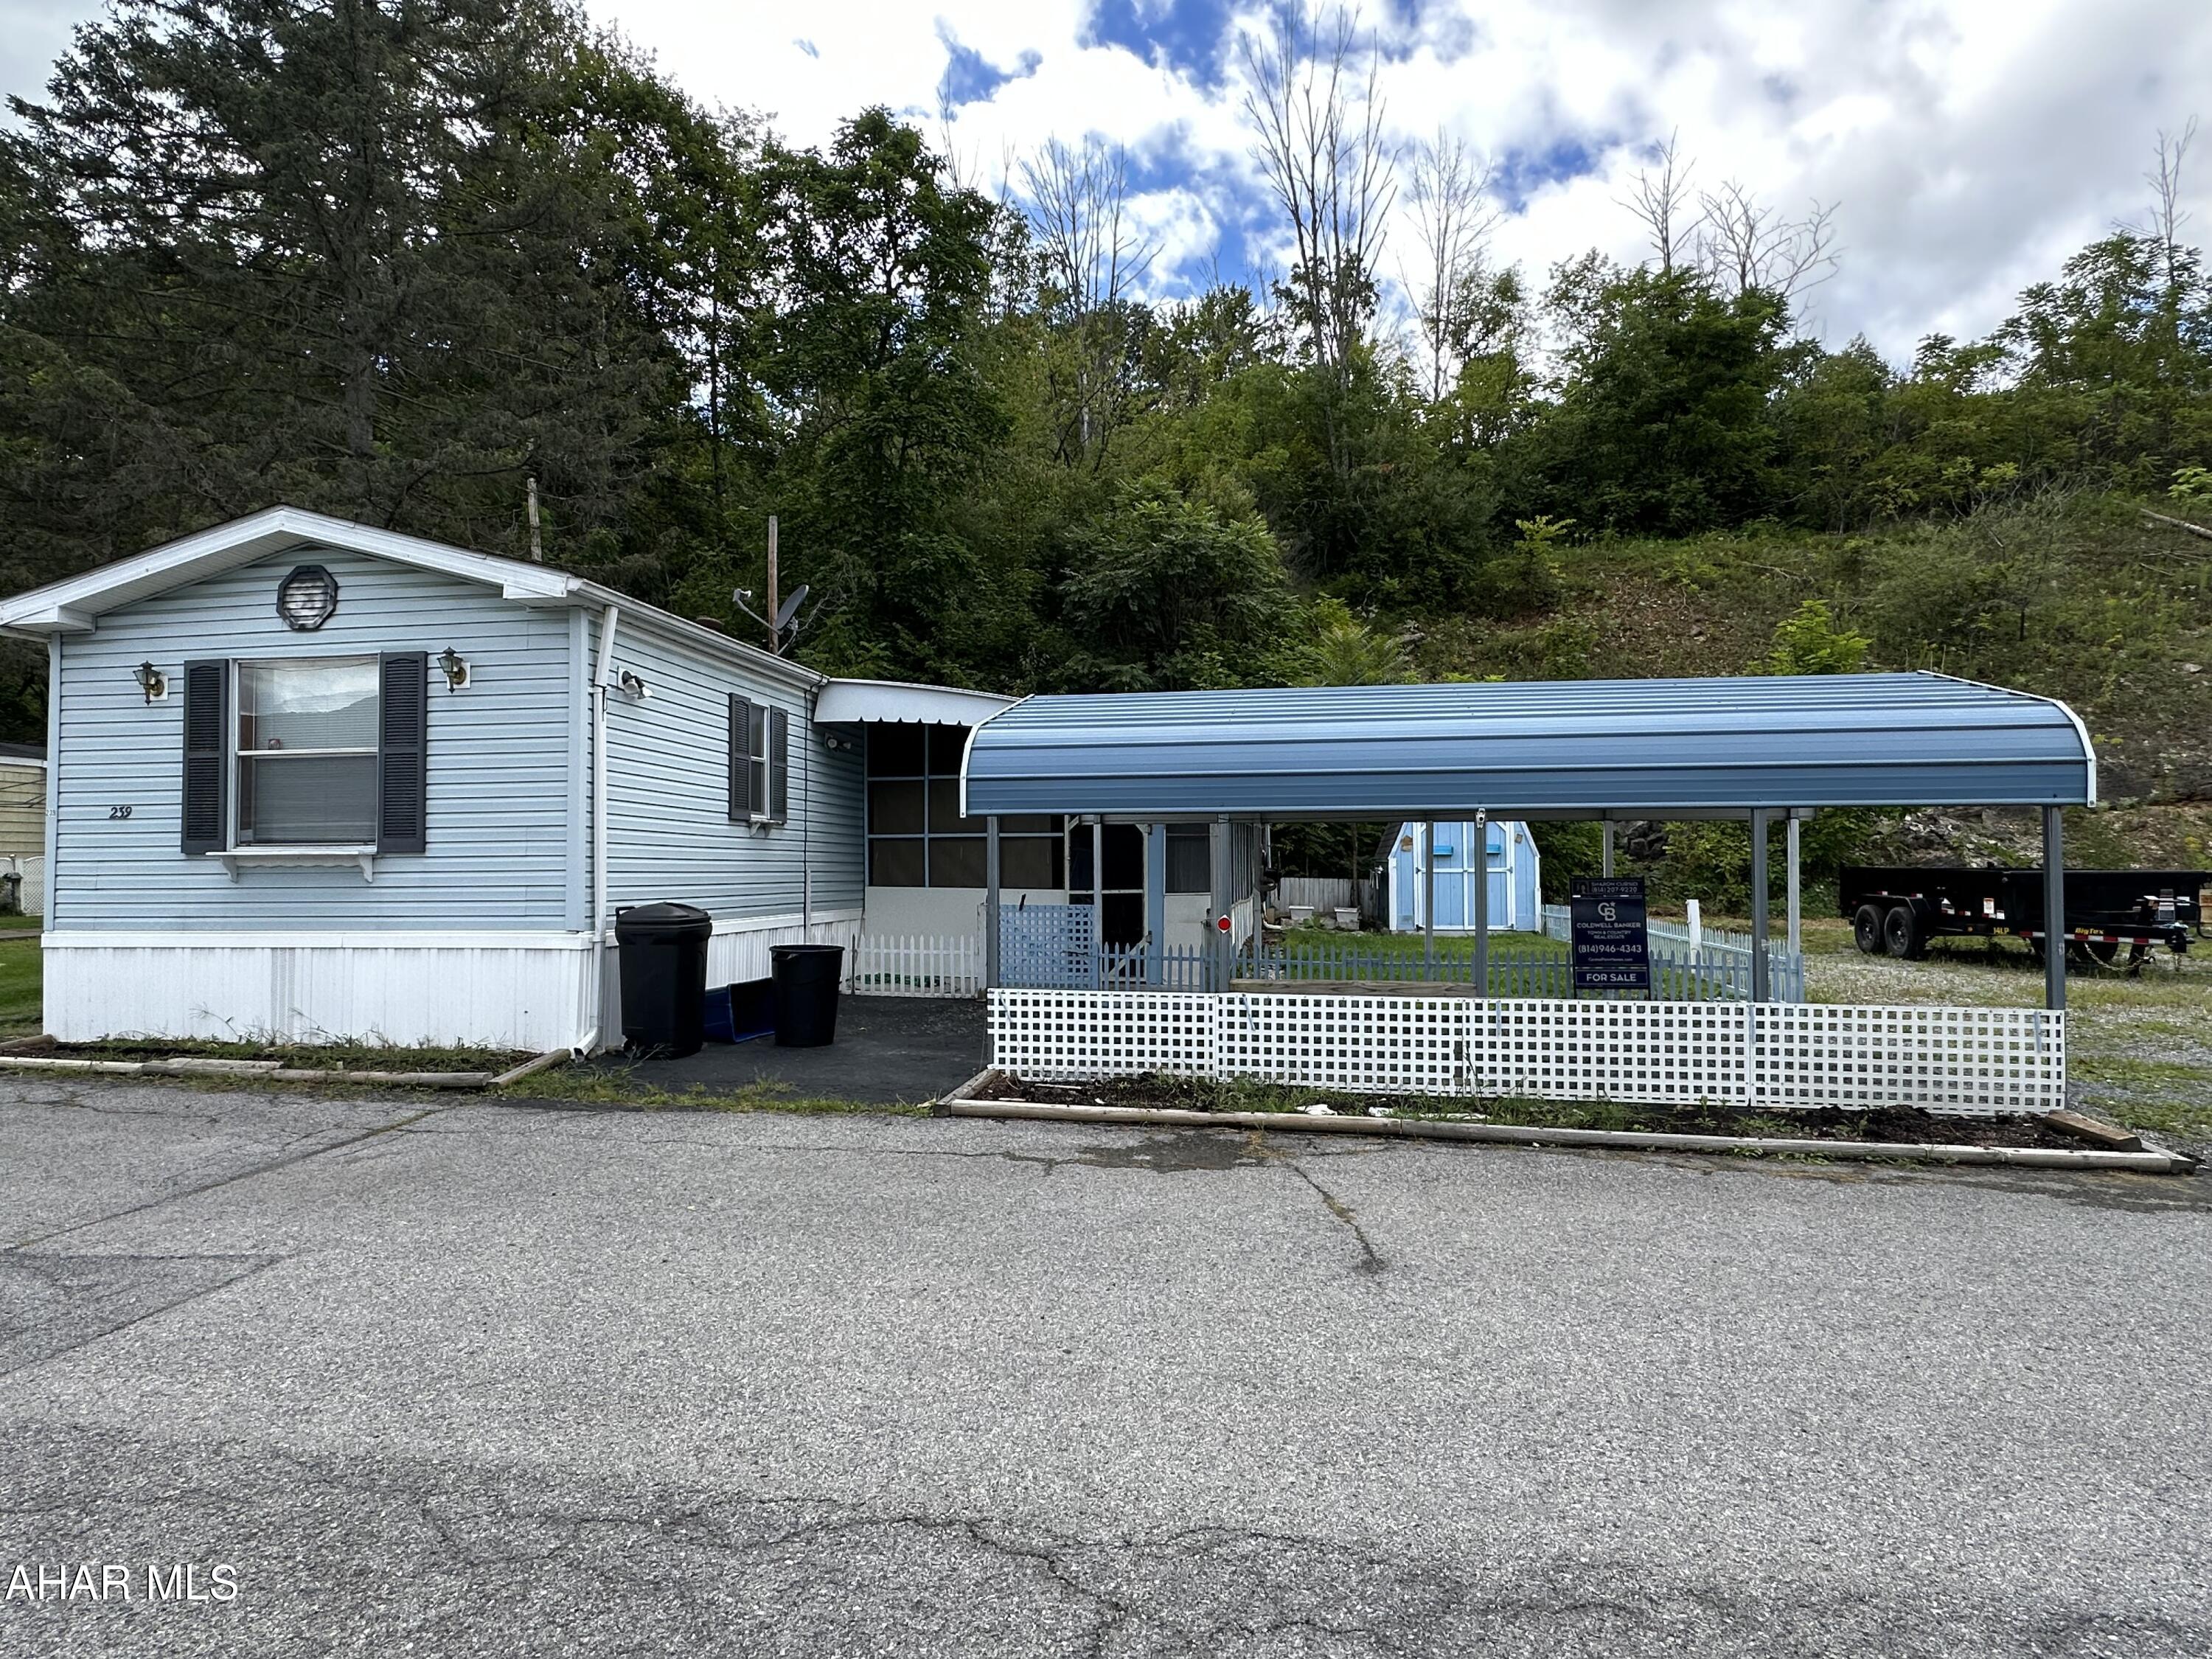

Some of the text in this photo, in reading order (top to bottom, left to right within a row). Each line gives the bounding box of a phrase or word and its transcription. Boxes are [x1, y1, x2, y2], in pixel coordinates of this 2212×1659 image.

[109, 806, 132, 819] 239
[1587, 973, 1637, 981] FOR SALE
